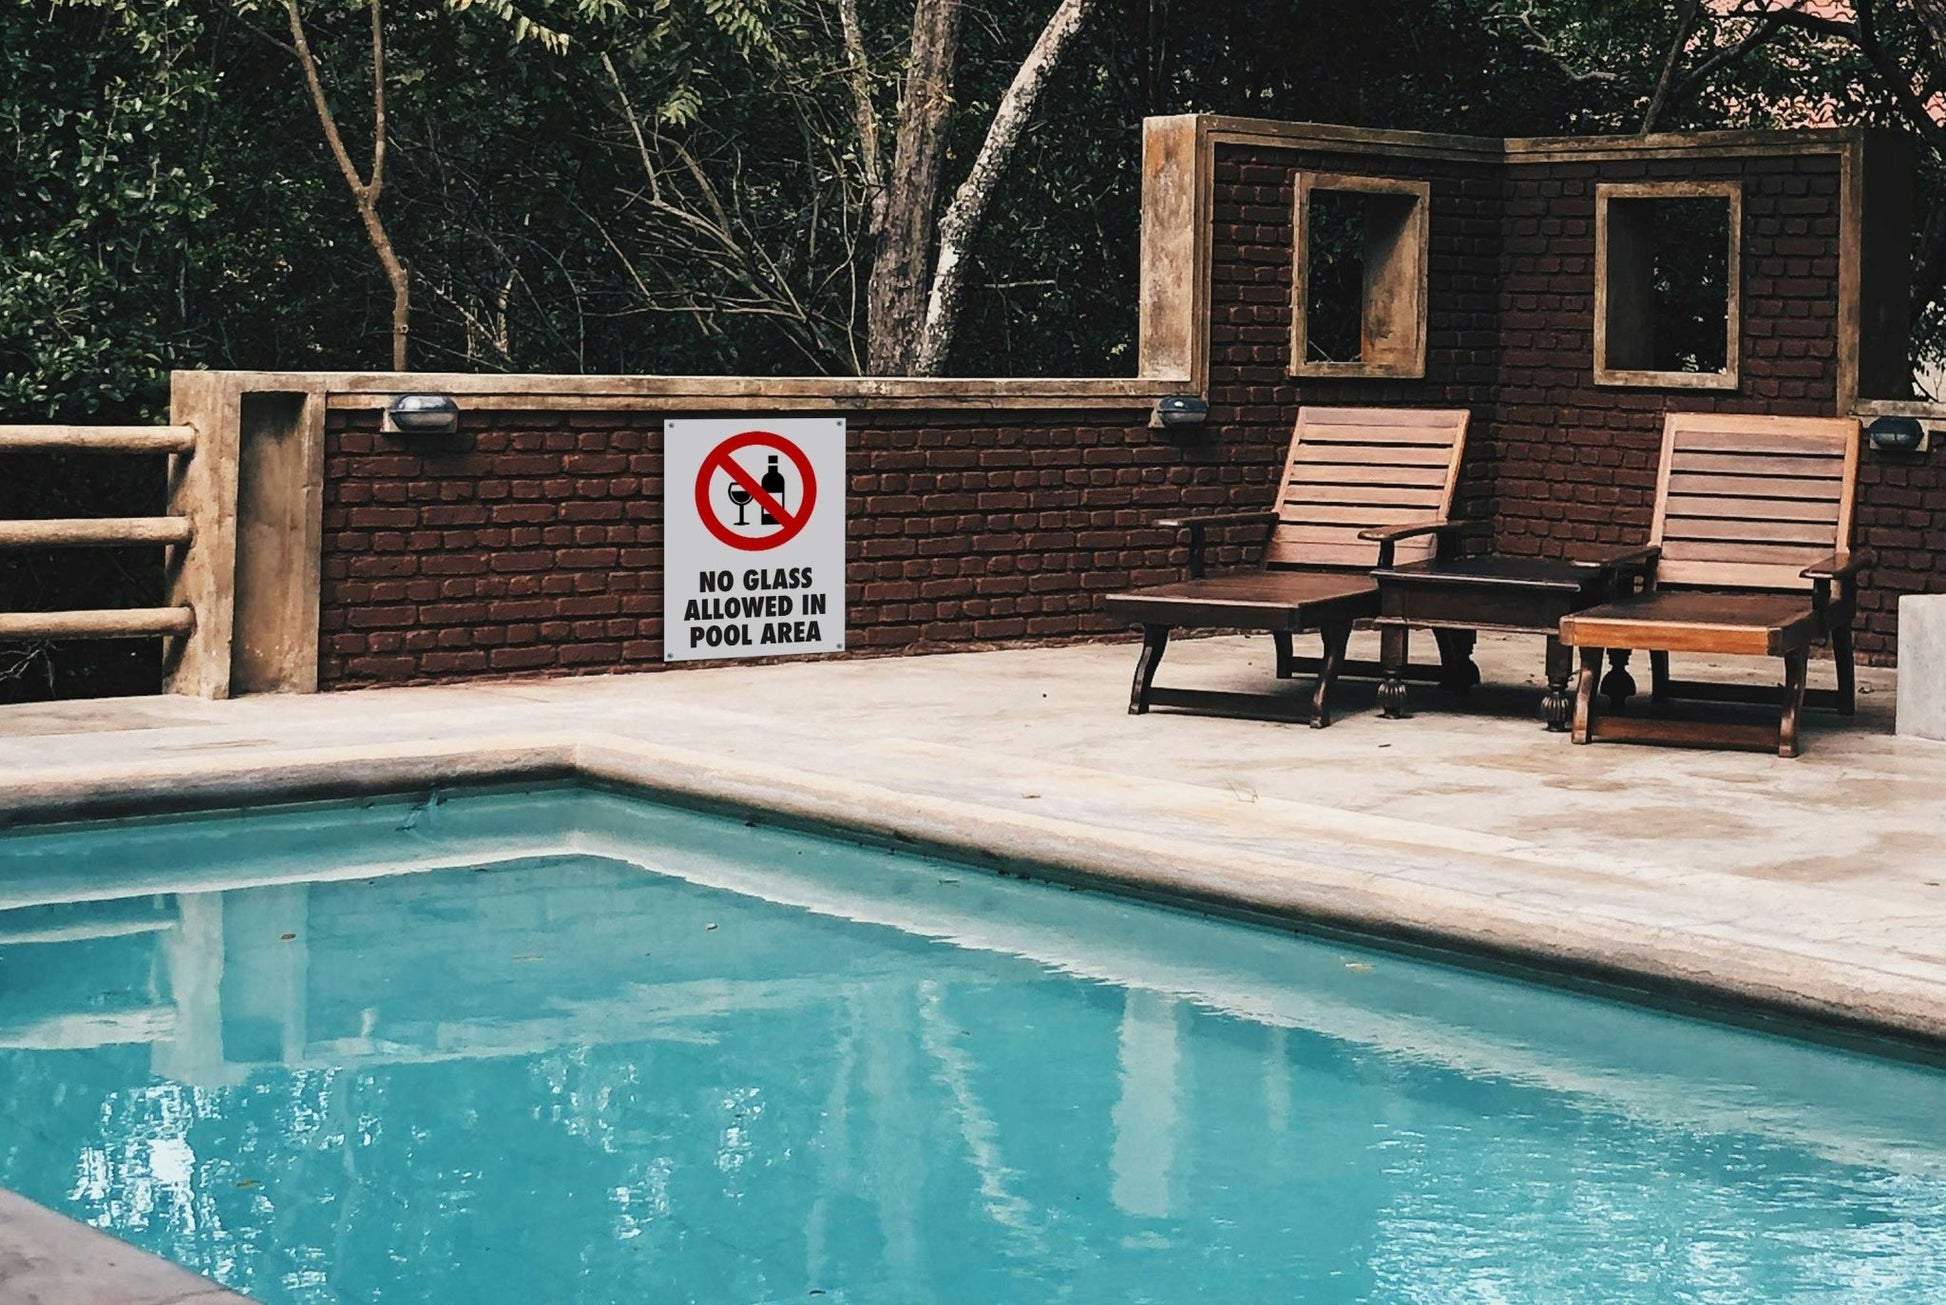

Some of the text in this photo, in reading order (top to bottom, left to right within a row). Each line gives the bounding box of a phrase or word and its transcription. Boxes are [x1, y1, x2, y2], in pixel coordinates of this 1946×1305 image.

[699, 567, 812, 593] NO GLASS
[684, 594, 826, 621] ALLOWED IN
[690, 621, 821, 648] POOL AREA
